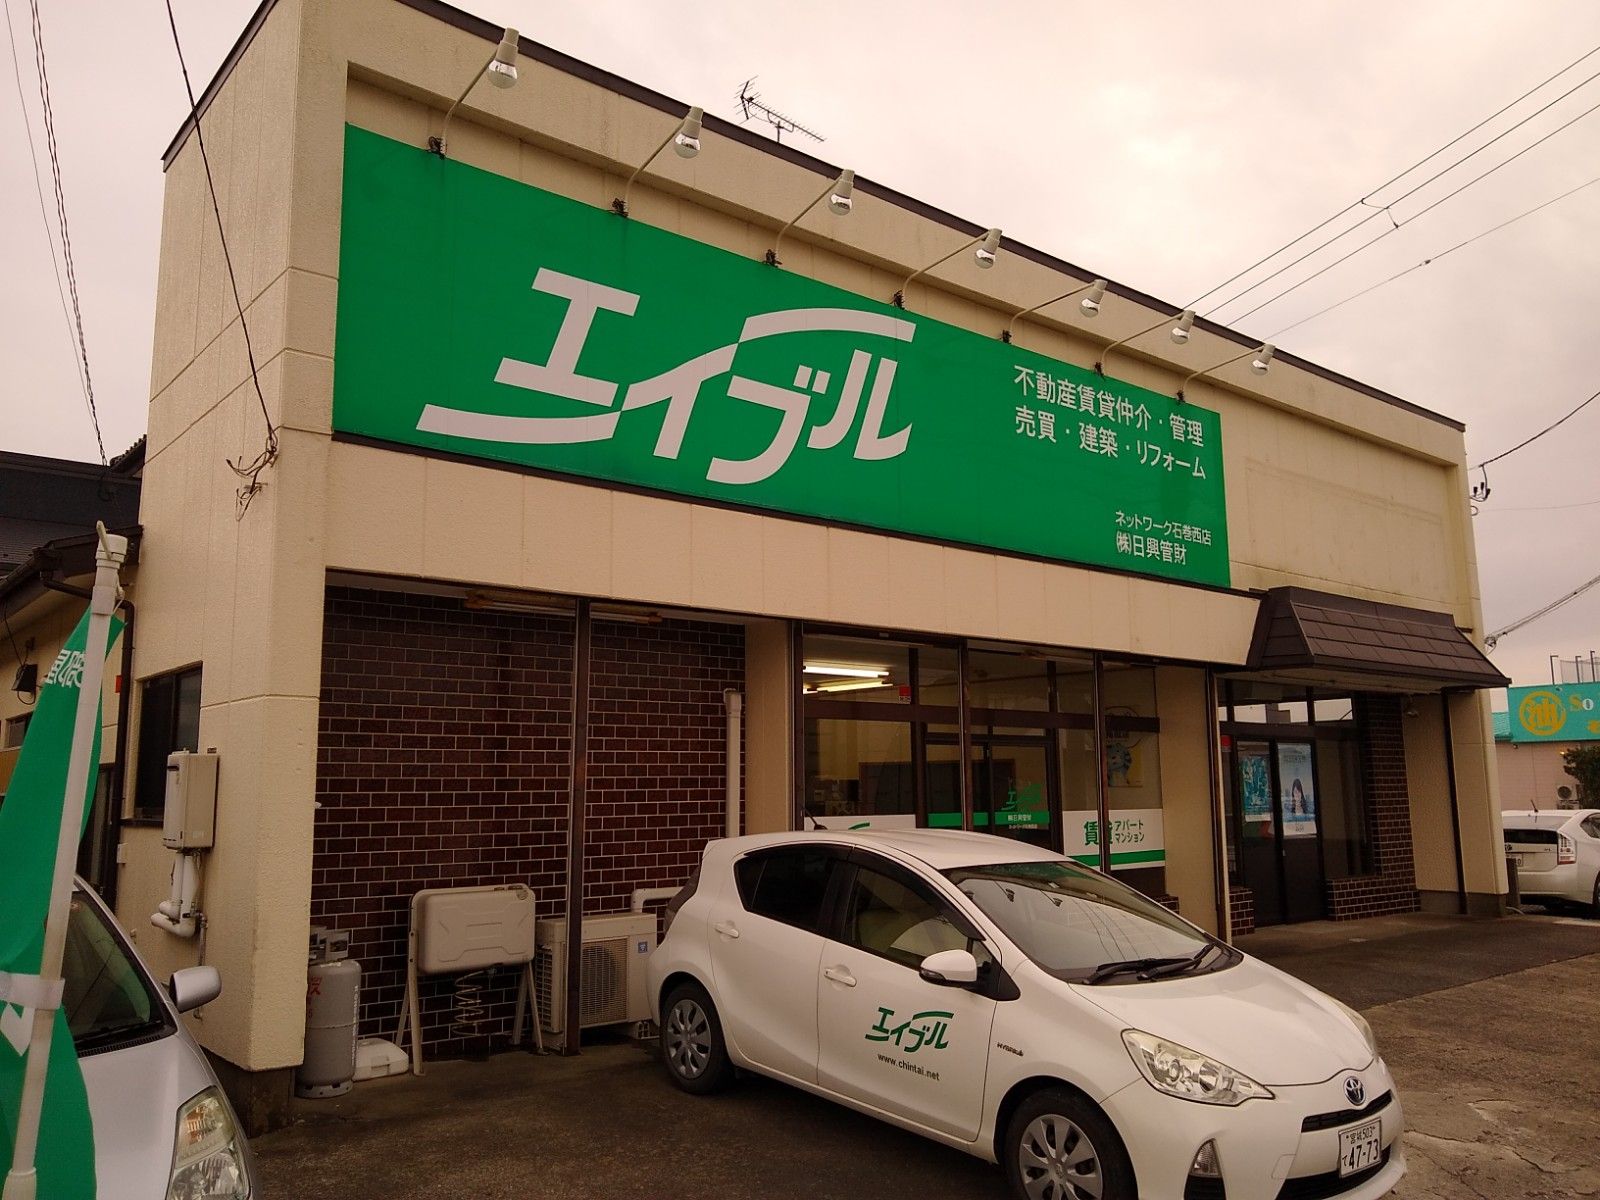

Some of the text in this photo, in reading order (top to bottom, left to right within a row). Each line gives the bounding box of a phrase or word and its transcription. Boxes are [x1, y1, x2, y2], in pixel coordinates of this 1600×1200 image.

[416, 267, 917, 484] エイブル
[1013, 365, 1204, 447] 不動産賃貸仲介・管理
[1015, 405, 1206, 479] 売買・建築・リフォーム
[1115, 510, 1212, 546] ネットワーク石巻西店
[1115, 819, 1145, 831] アパート
[1115, 831, 1145, 844] マンション
[865, 1006, 954, 1053] エイブル
[877, 1053, 940, 1081] www.chintai.net
[1348, 1138, 1379, 1170] 47-73
